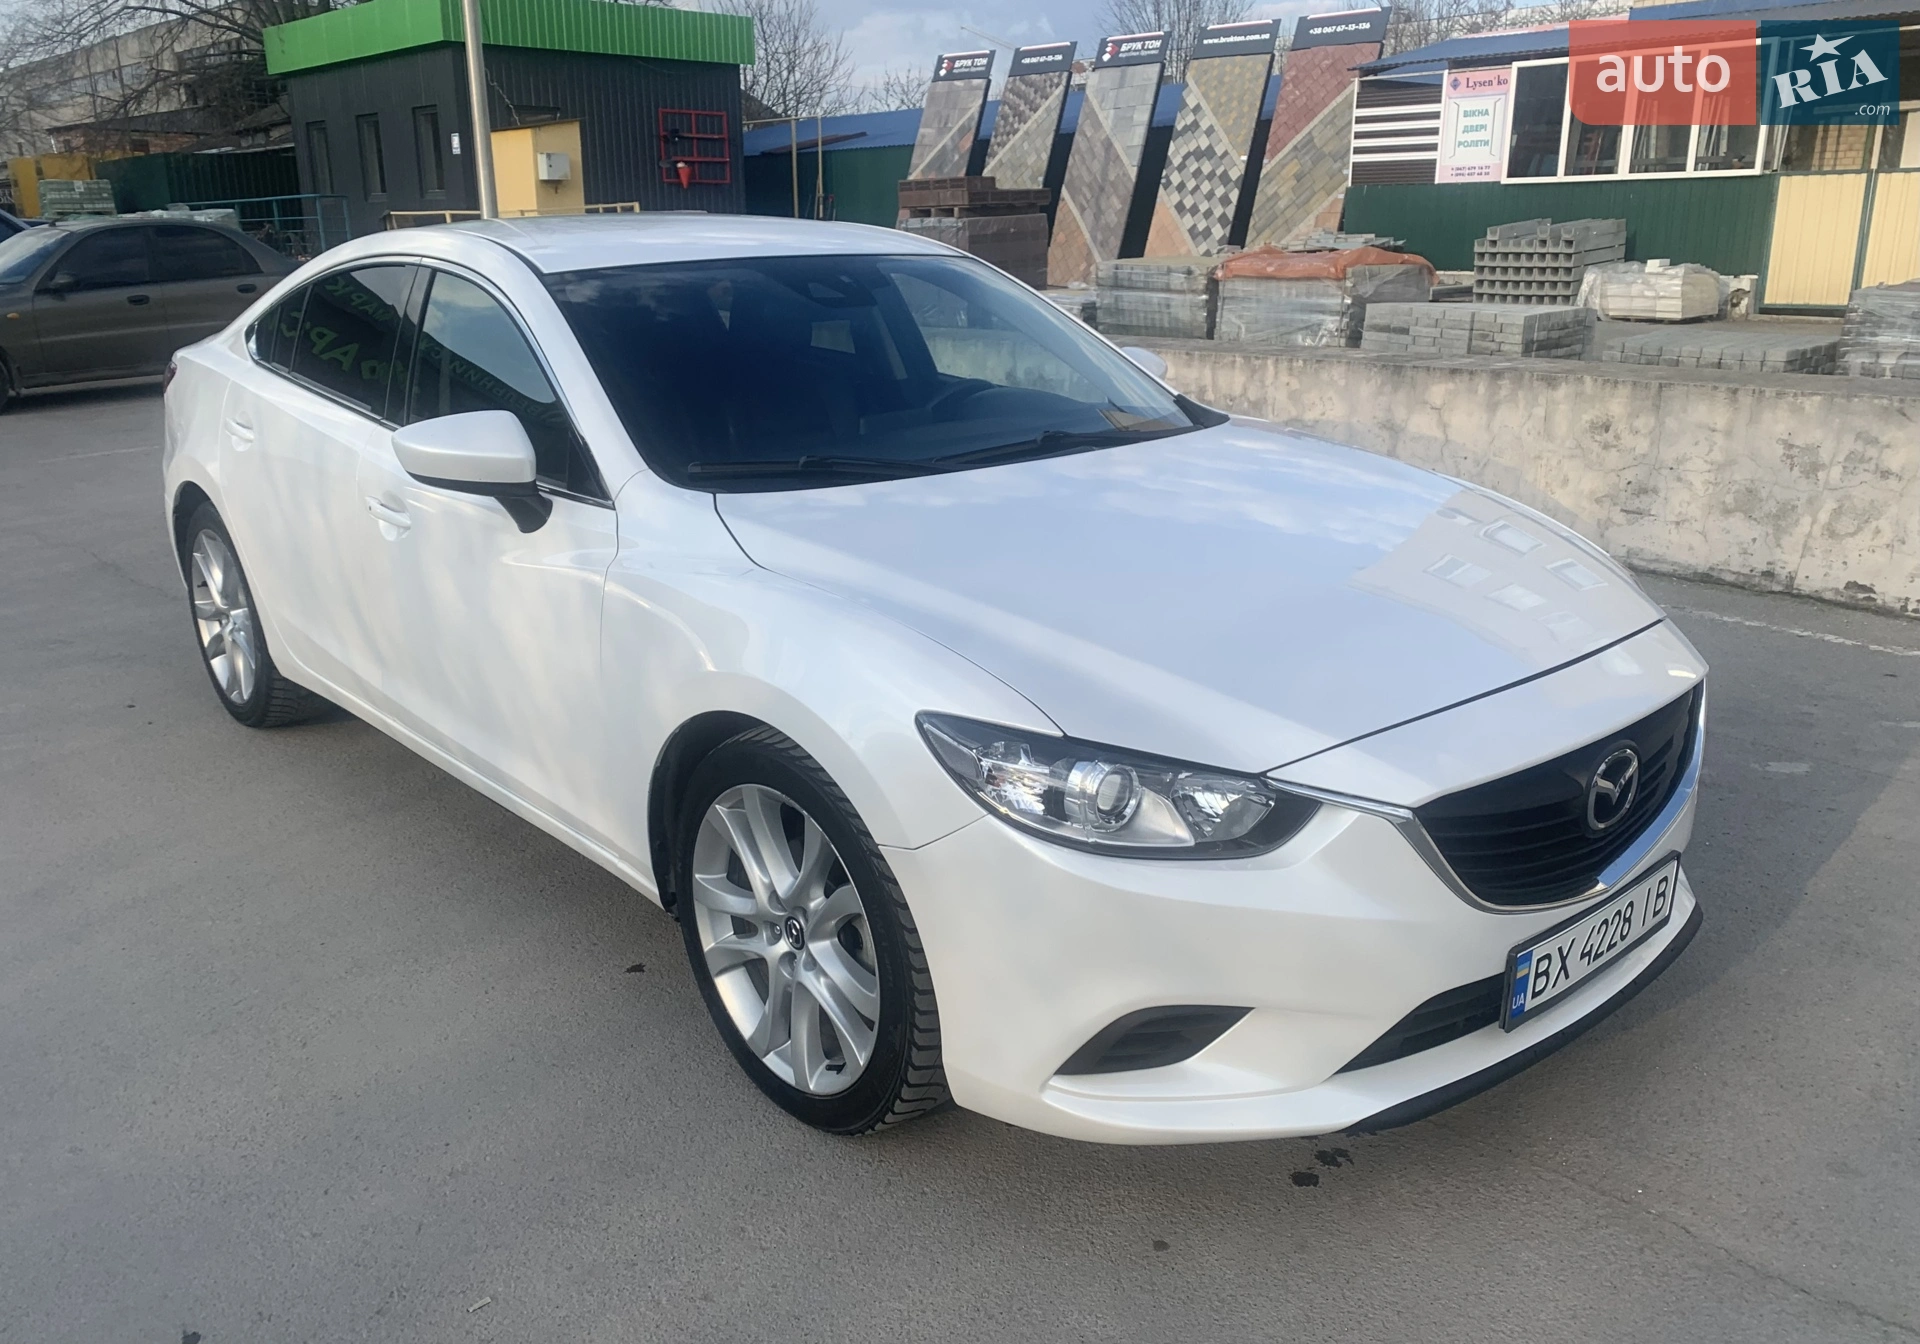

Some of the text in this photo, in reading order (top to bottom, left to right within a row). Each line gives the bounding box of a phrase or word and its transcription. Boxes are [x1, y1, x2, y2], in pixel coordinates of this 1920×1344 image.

[1336, 22, 1371, 33] 67-13-136
[1203, 33, 1270, 44] www.brukton.com.ua
[1120, 40, 1162, 51] БРУК ТОН
[953, 57, 988, 68] БРУК ТОН
[1466, 75, 1509, 91] Lysen'ko
[1463, 108, 1490, 118] ВІКНА
[1462, 123, 1488, 135] ДВЕРІ
[1457, 139, 1490, 148] РОЛЕТИ
[1531, 875, 1669, 1000] BX 4228 IB
[1512, 992, 1525, 1009] UA
